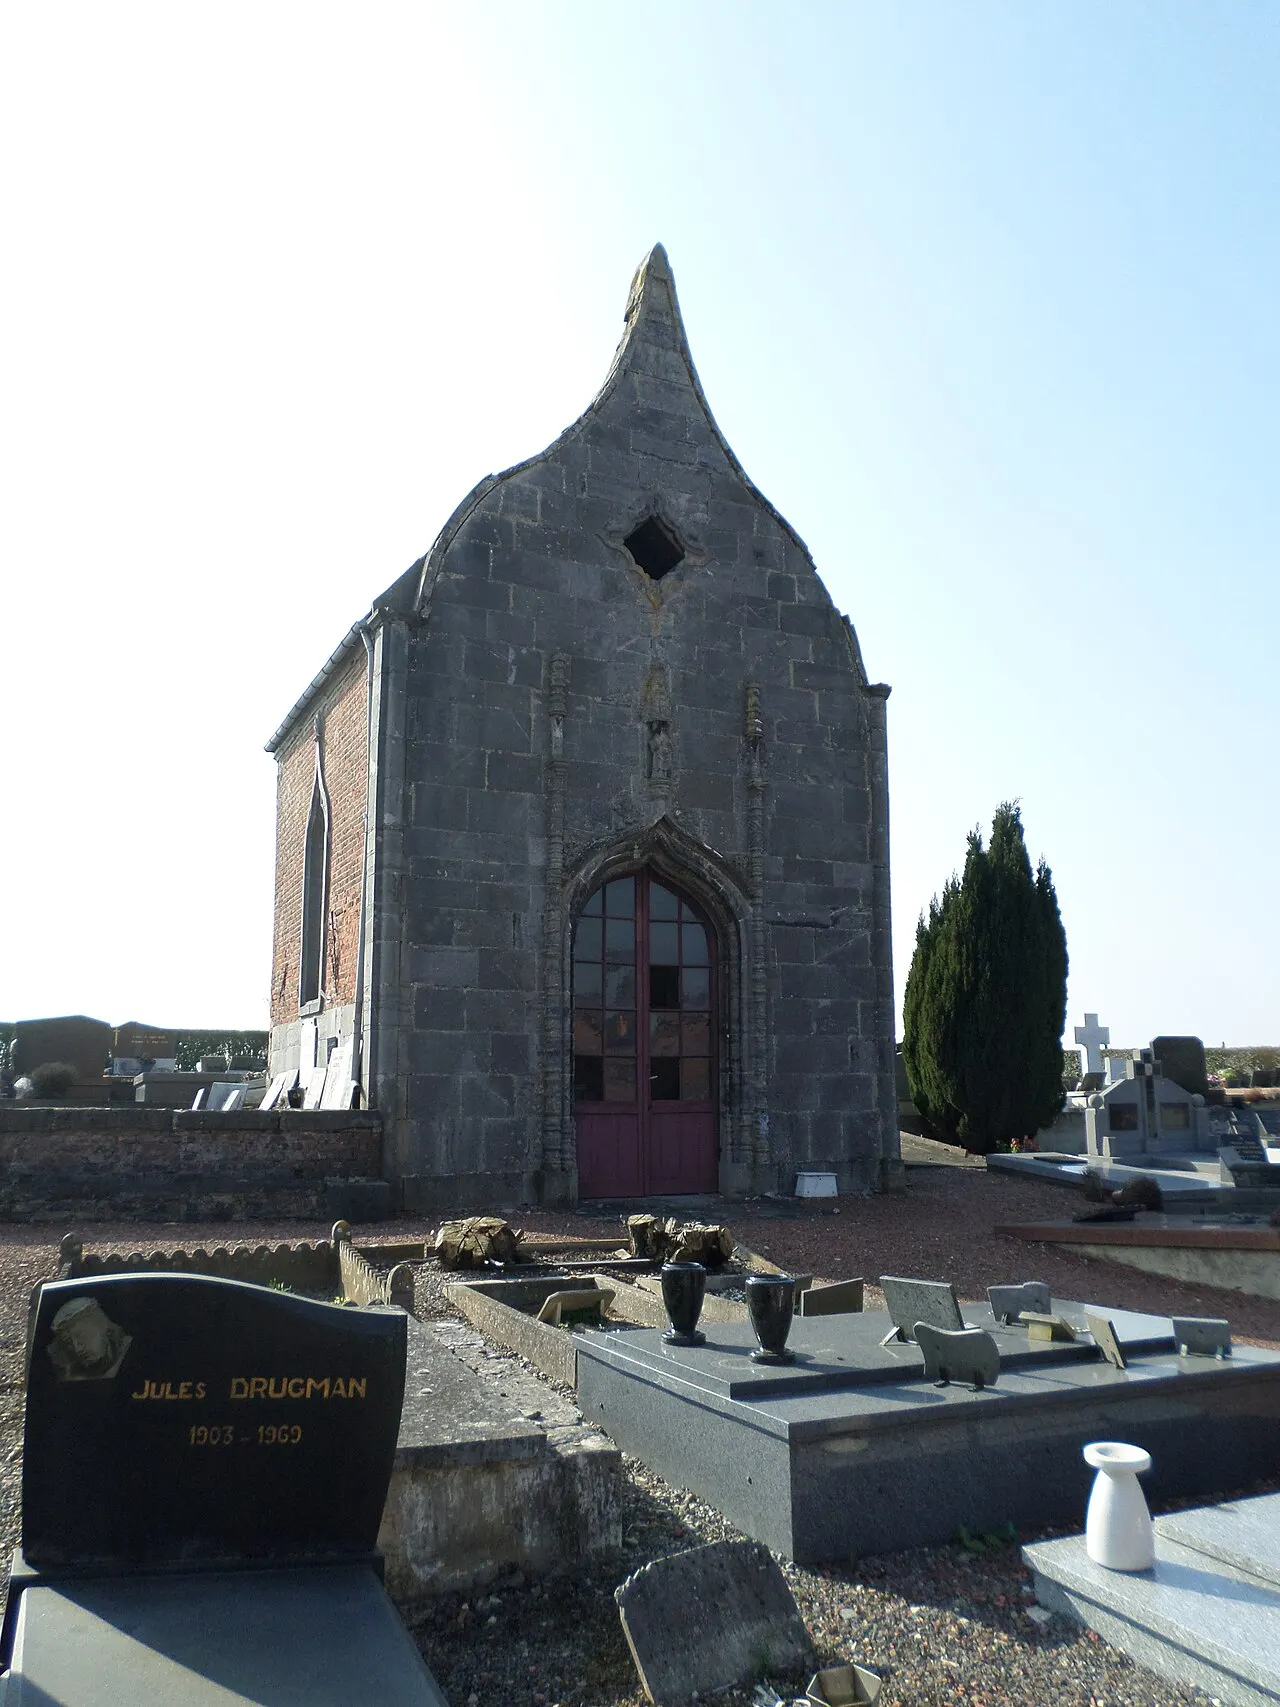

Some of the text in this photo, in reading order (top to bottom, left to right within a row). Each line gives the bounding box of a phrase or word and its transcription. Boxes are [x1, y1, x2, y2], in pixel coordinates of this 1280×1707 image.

[132, 1377, 367, 1400] JULES DRUGMAN
[189, 1424, 234, 1445] 1903
[258, 1424, 302, 1445] 1969
